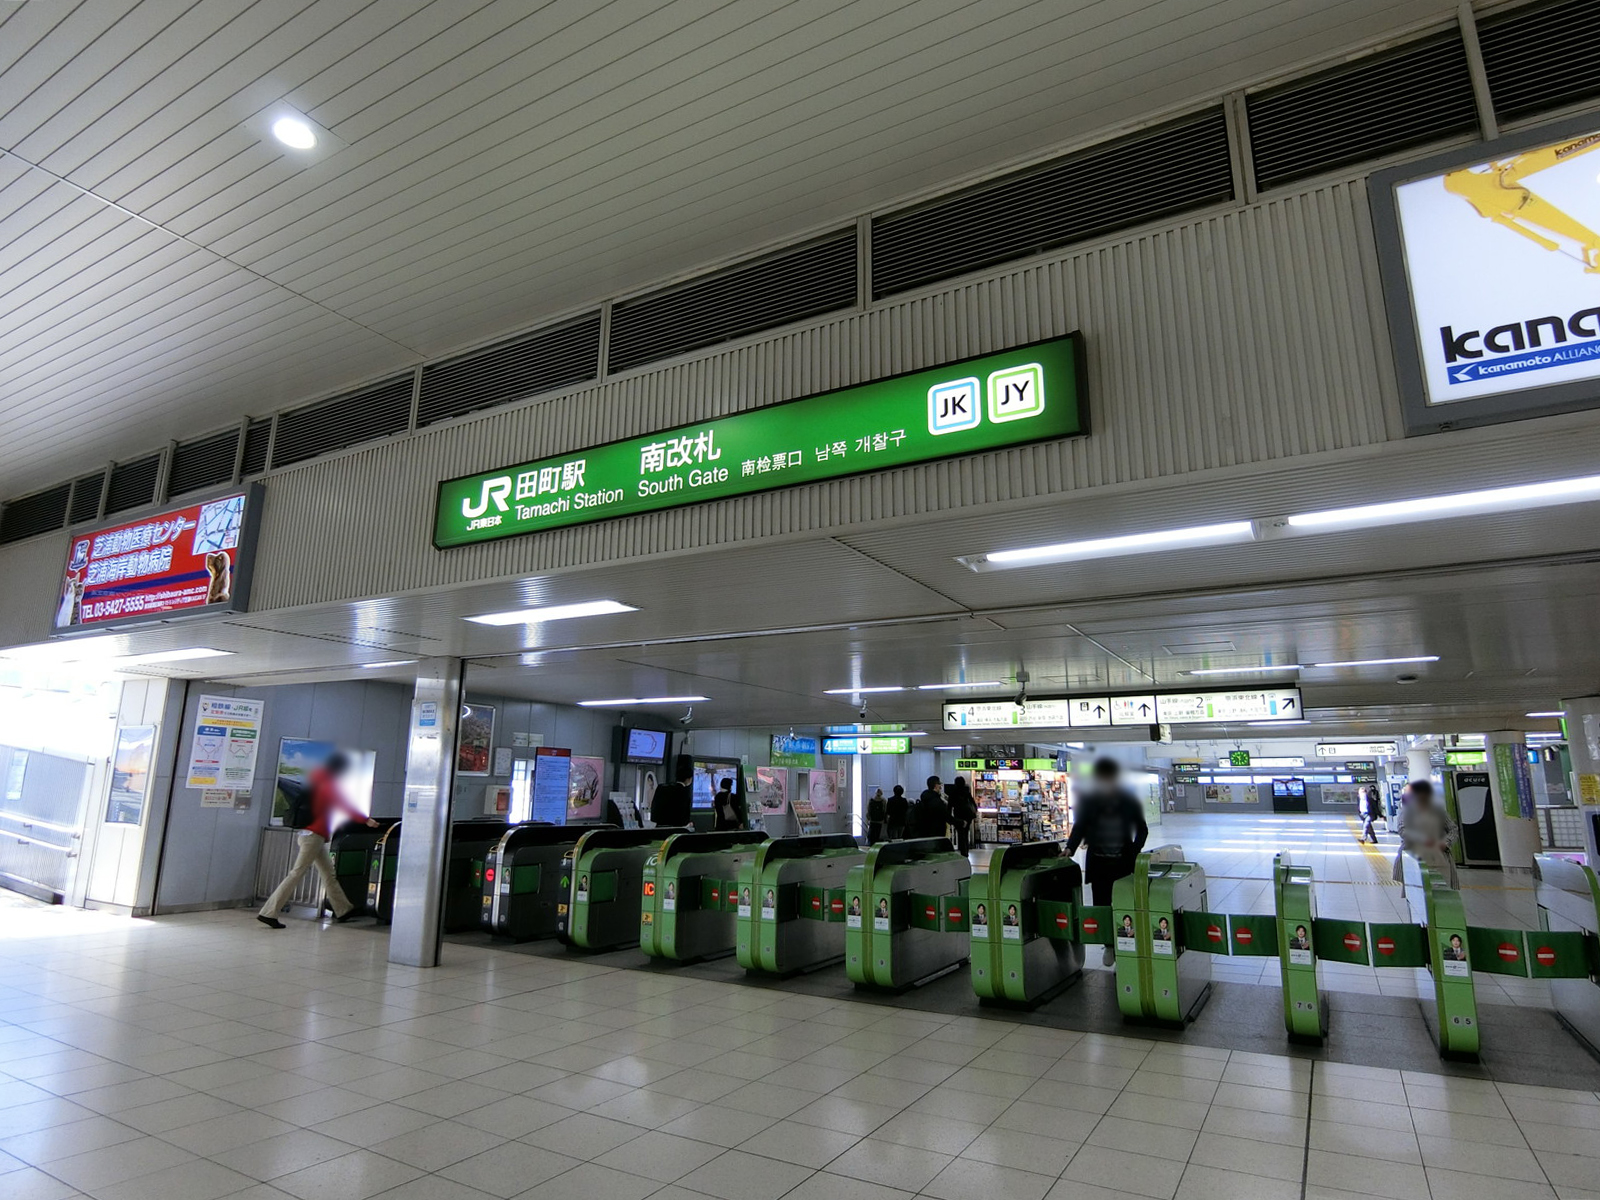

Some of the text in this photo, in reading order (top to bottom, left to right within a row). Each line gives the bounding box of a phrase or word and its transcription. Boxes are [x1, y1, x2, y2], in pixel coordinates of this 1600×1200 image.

[1478, 355, 1551, 376] kanamoto
[1000, 380, 1030, 406] JY
[940, 394, 967, 418] JK
[640, 430, 722, 475] 南改札
[815, 430, 906, 462] 남쪽 개찰구
[741, 450, 802, 477] 南检票口
[515, 459, 586, 501] 田町駅
[638, 466, 729, 498] South Gate
[462, 475, 513, 518] JR
[515, 488, 624, 520] Tamachi Station
[466, 515, 502, 531] JR東日本
[1195, 697, 1203, 708] 2
[1260, 694, 1265, 705] 1
[968, 706, 974, 716] 4
[1019, 705, 1026, 716] 3
[824, 740, 832, 752] 4
[898, 739, 906, 752] 3
[990, 759, 1018, 767] KIOSK
[645, 882, 655, 895] IC
